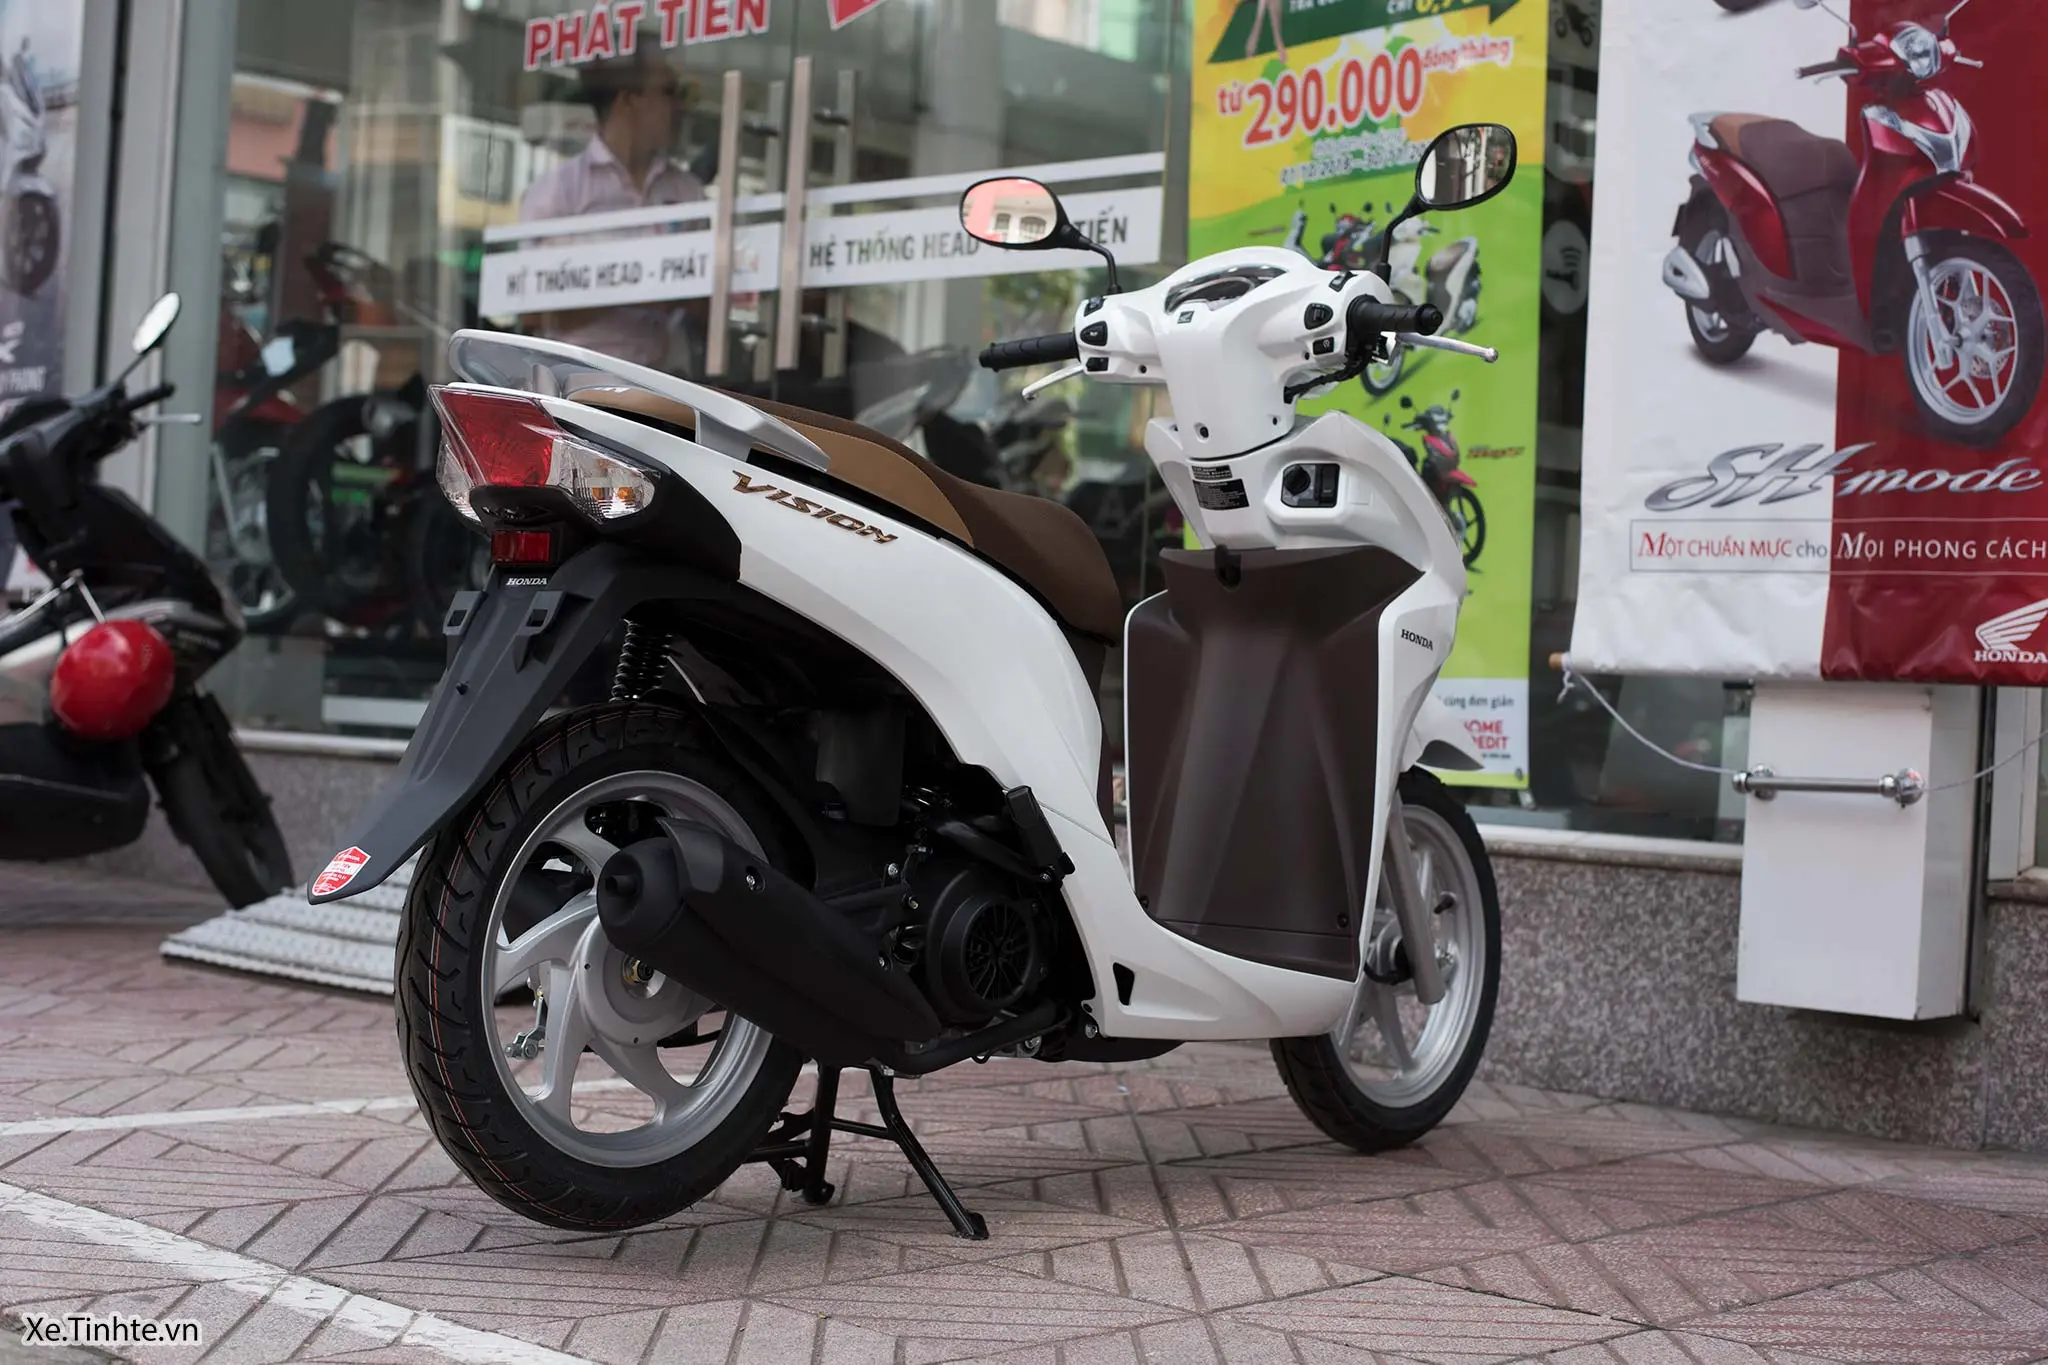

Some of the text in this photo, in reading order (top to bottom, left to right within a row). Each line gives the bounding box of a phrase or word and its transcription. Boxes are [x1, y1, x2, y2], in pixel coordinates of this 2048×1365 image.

[1243, 46, 1423, 146] 290.000
[921, 231, 980, 259] HEAD
[1644, 441, 2044, 513] SH mode
[732, 470, 899, 545] VISION
[1796, 540, 1828, 559] cho
[1895, 540, 1977, 560] PHONG
[1985, 536, 2048, 560] CÁCH
[505, 577, 548, 586] HONDA
[1400, 628, 1434, 652] HONDA
[1974, 650, 2048, 664] HONDA
